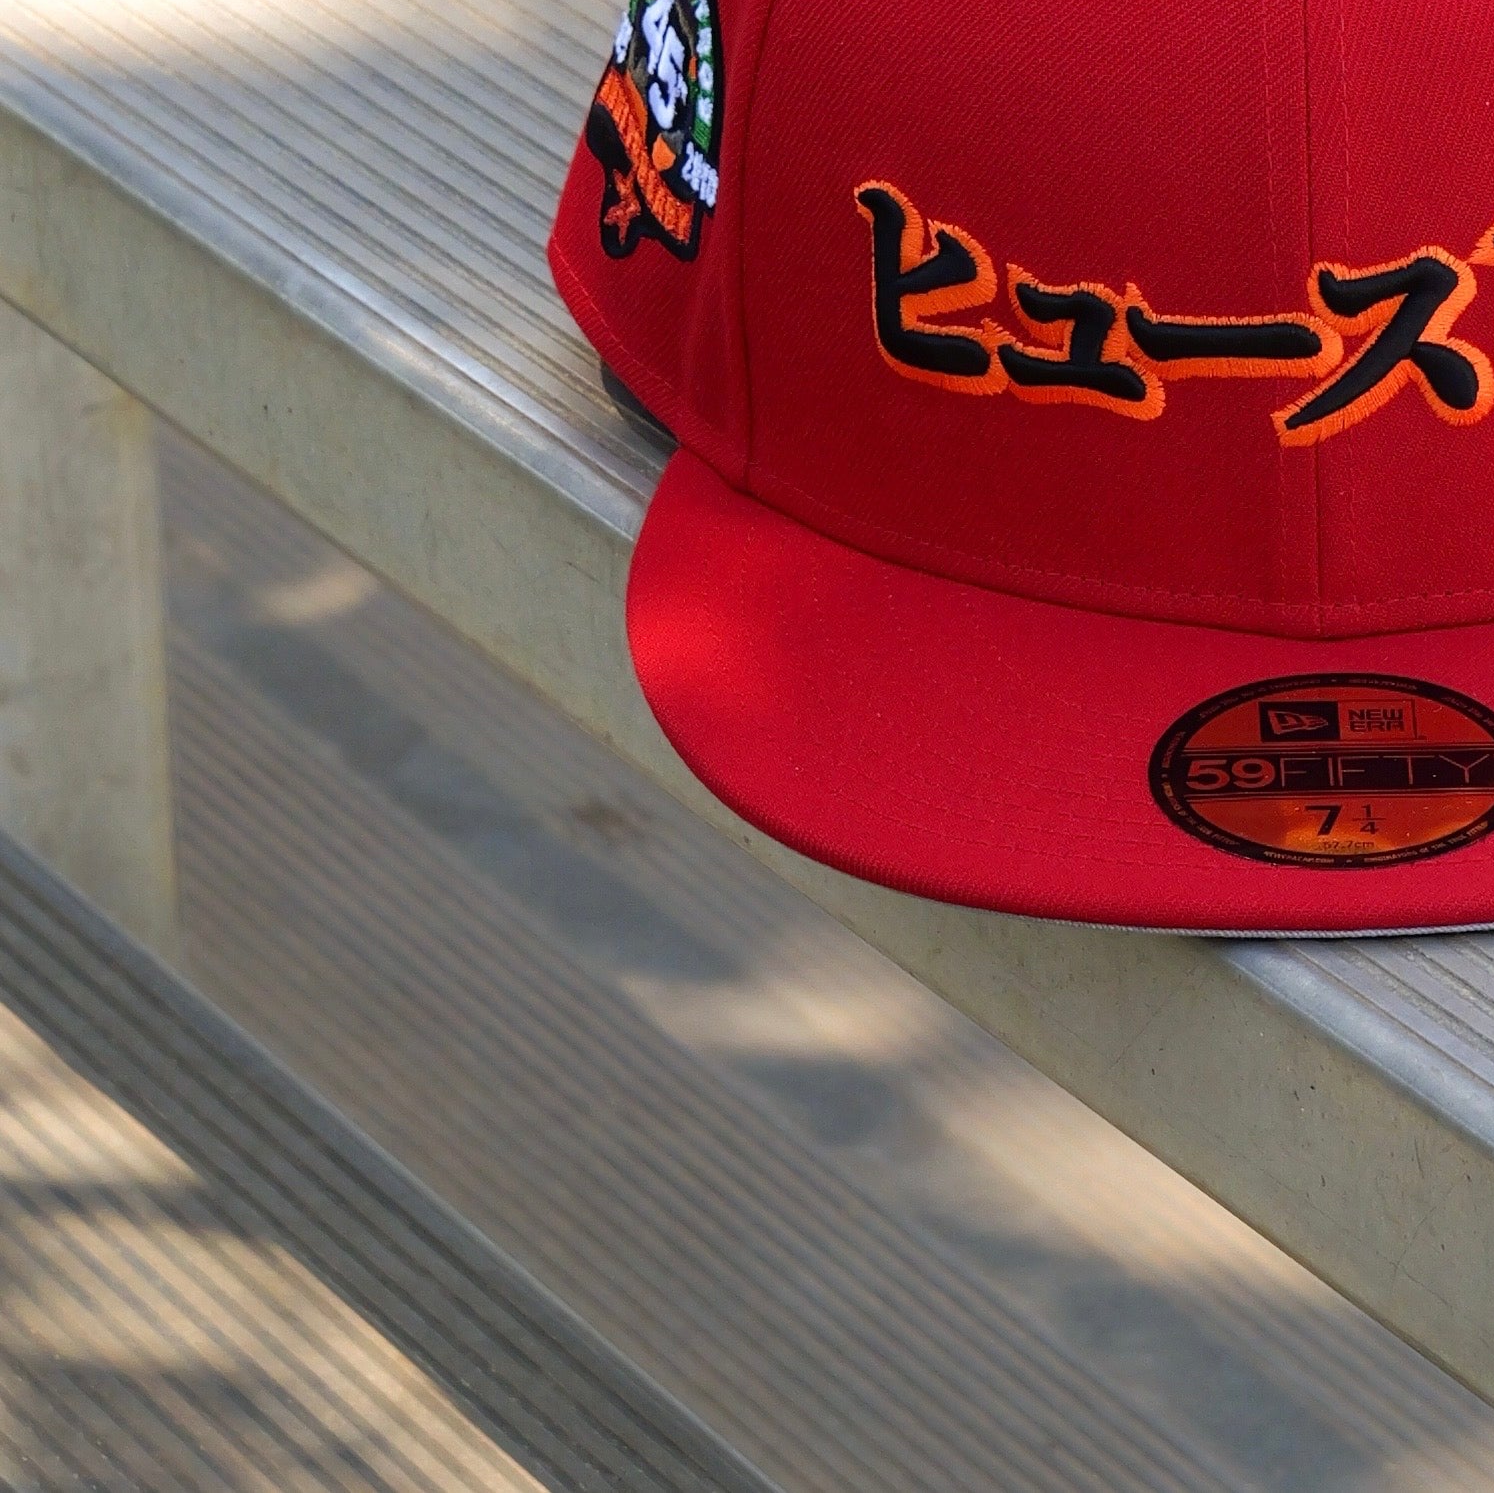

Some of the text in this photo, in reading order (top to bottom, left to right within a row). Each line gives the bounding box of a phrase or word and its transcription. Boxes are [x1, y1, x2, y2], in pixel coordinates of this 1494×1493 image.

[1348, 708, 1404, 721] NEW
[1349, 720, 1405, 733] ERA
[1186, 753, 1491, 791] 59FIFTY
[1304, 804, 1343, 837] 7
